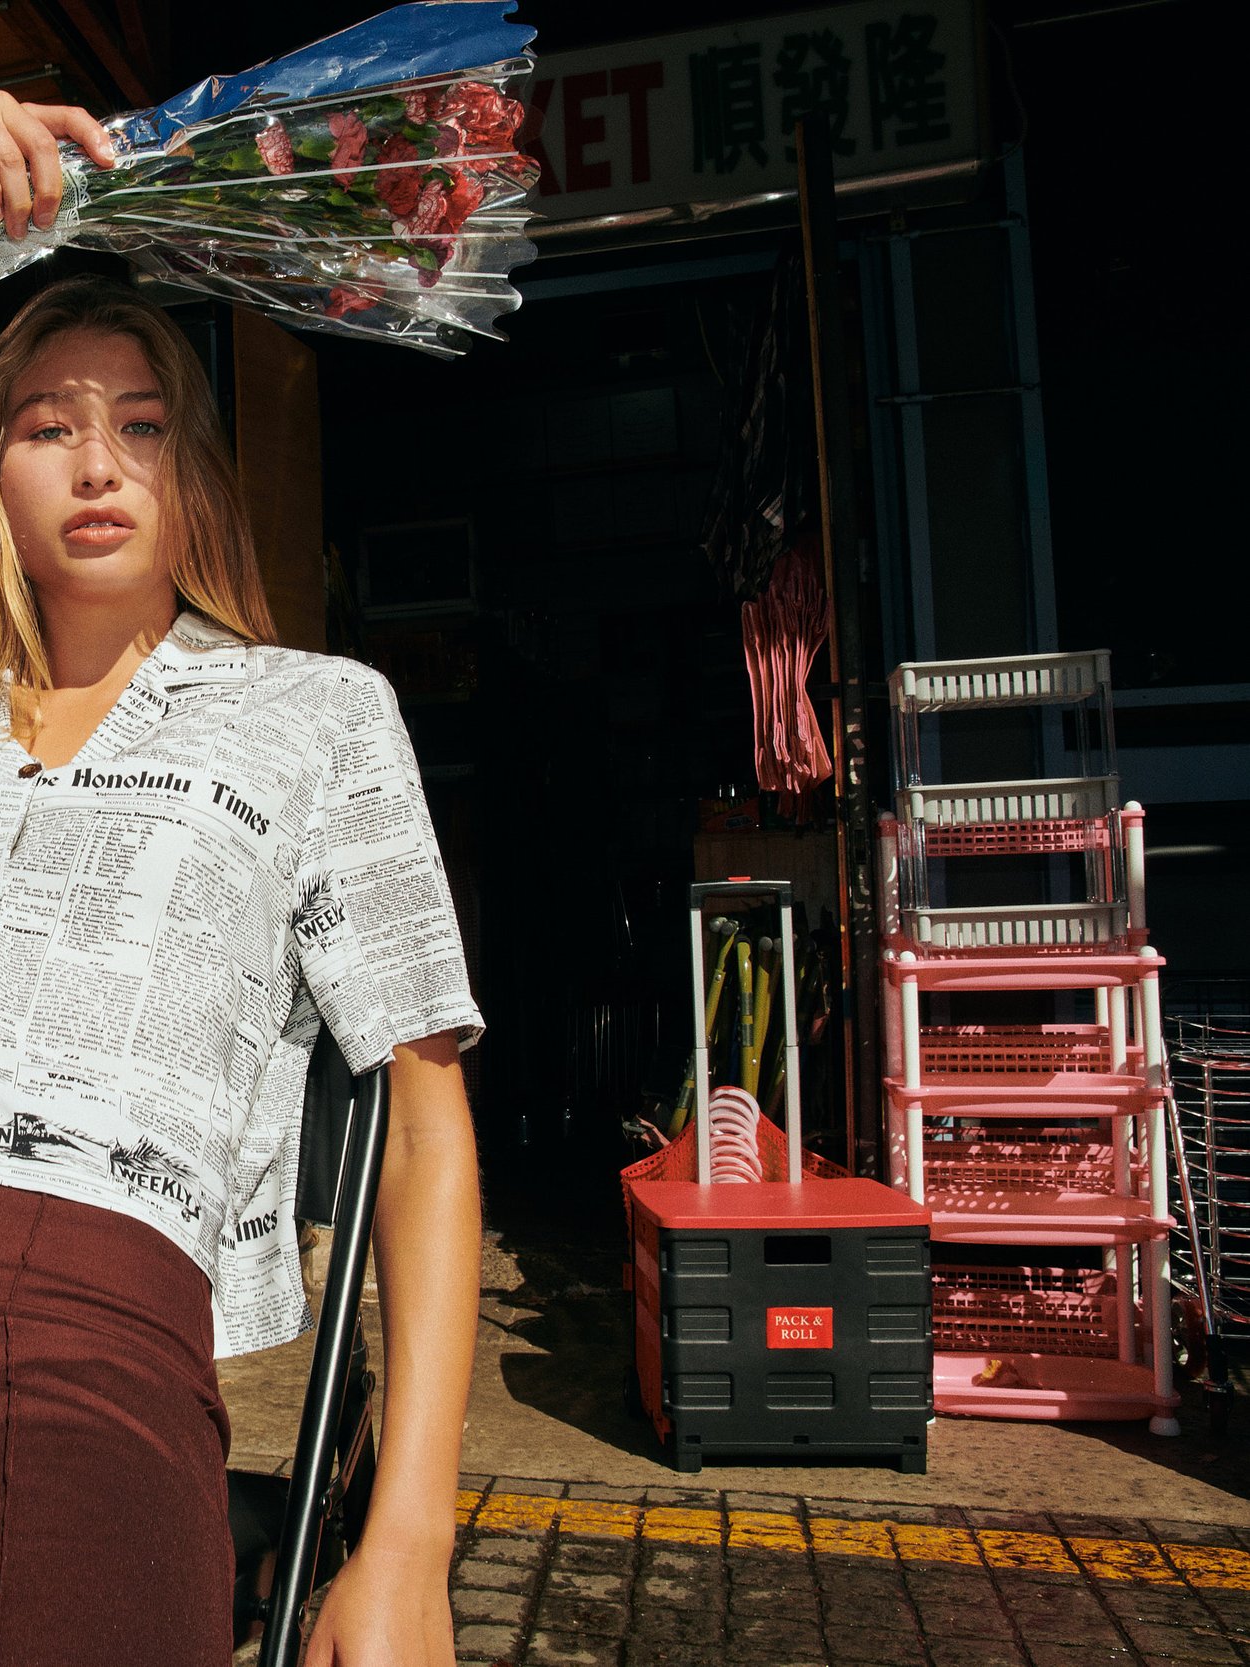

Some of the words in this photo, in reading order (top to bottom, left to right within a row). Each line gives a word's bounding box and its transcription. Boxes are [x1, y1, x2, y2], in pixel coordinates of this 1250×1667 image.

[72, 767, 192, 794] Honolulu
[211, 780, 270, 836] Times
[134, 812, 174, 824] Domestics,
[242, 970, 264, 988] LADD
[80, 1094, 99, 1102] LADD
[118, 1165, 192, 1206] WEEKLY
[774, 1315, 809, 1326] PACK
[813, 1315, 824, 1326] &
[781, 1328, 817, 1340] ROLL
